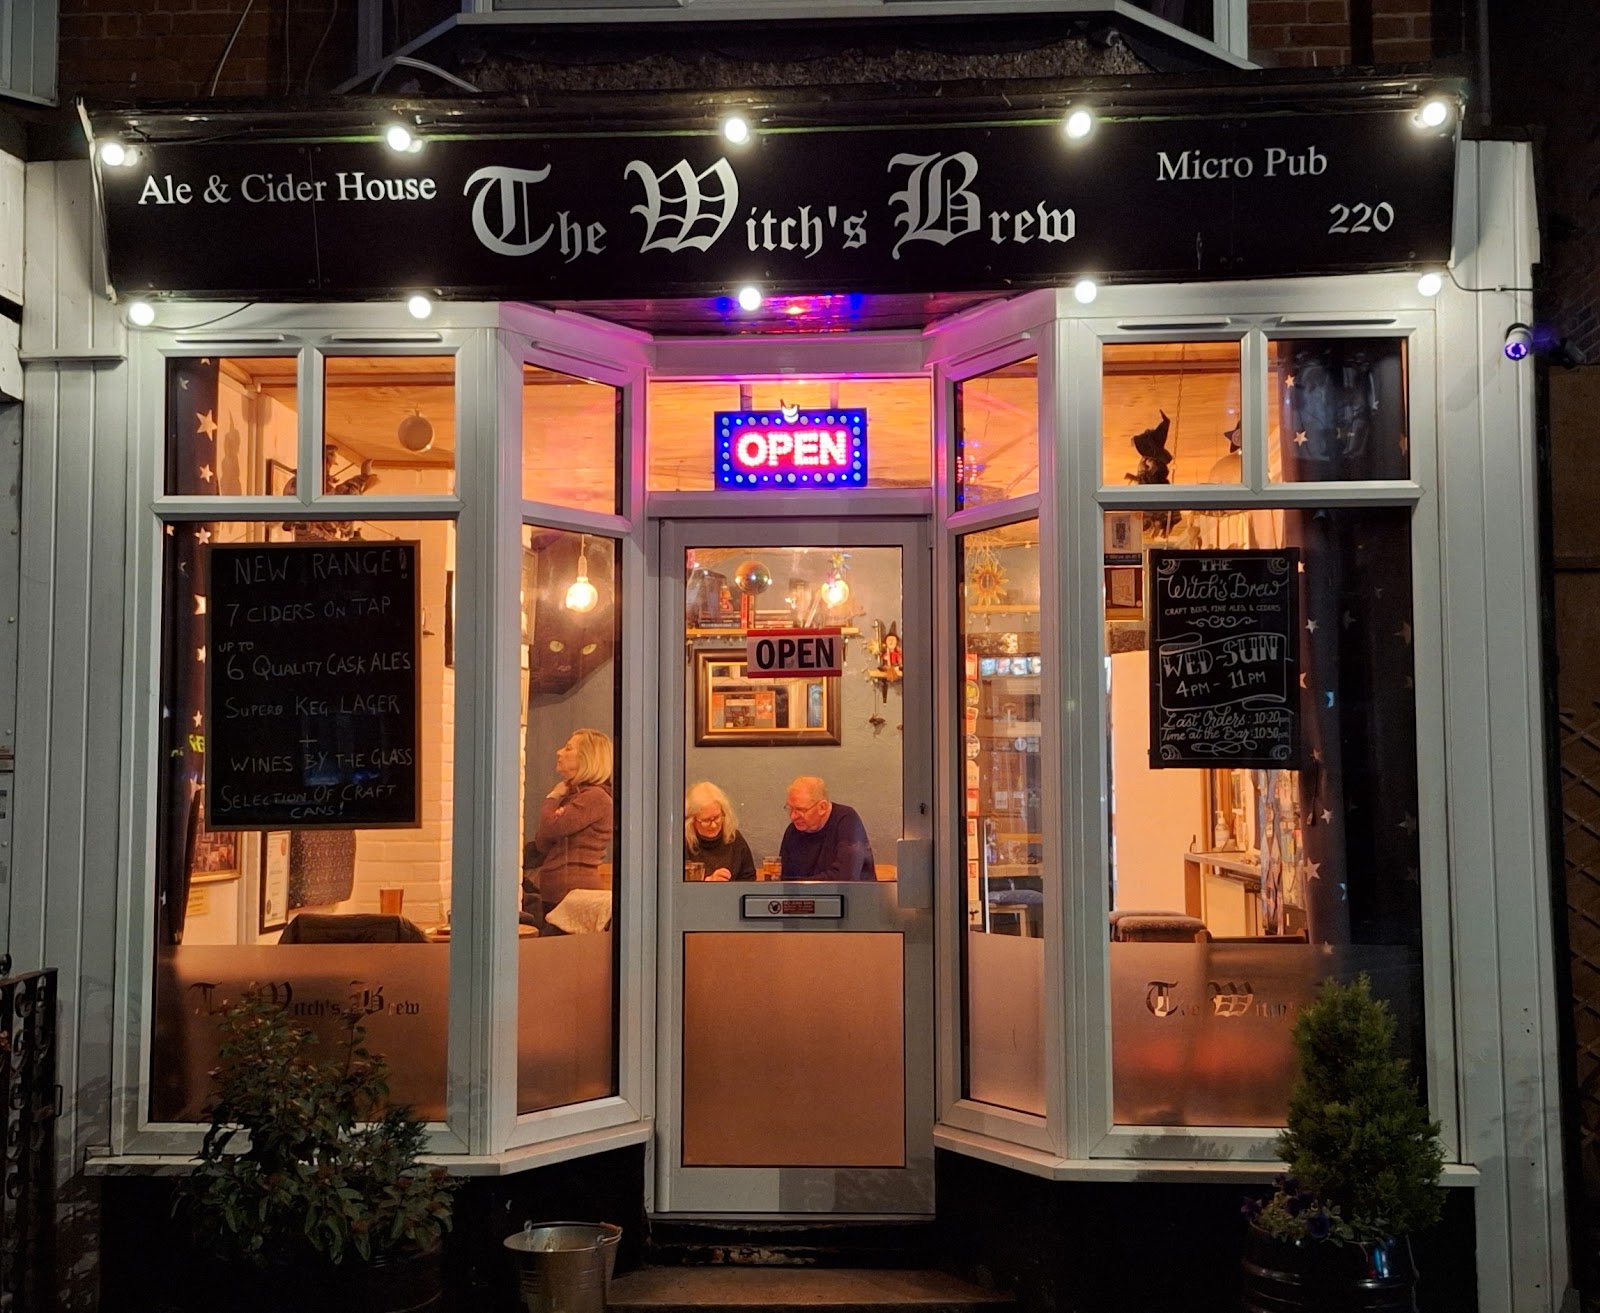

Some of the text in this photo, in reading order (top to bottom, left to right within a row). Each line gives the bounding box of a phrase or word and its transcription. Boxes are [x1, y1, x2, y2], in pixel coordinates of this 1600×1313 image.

[1156, 146, 1328, 181] Micro Pub
[138, 171, 437, 206] Ale & Cider House
[463, 151, 1077, 264] The Witch's Brew
[1328, 201, 1395, 235] 220
[737, 430, 847, 467] OPEN
[234, 555, 290, 585] NEW
[1199, 559, 1233, 572] THE
[1163, 572, 1284, 602] Witch's Brew
[226, 603, 240, 627] 7
[247, 602, 316, 623] CIDERS
[351, 595, 391, 616] TAP
[218, 641, 255, 653] UP TO
[755, 637, 835, 671] OPEN
[227, 651, 411, 681] 6 QUALITY CASK ALES
[1175, 680, 1211, 698] 4PM
[1227, 669, 1267, 690] 11PM
[295, 695, 328, 717] KEG
[340, 694, 401, 715] LAGER
[1163, 711, 1202, 729] Last
[1202, 726, 1220, 739] the
[230, 747, 413, 774] WINES BY THE GLASS
[220, 784, 307, 813] SELECTION
[340, 783, 397, 801] CRAFT
[289, 803, 344, 819] CANS!
